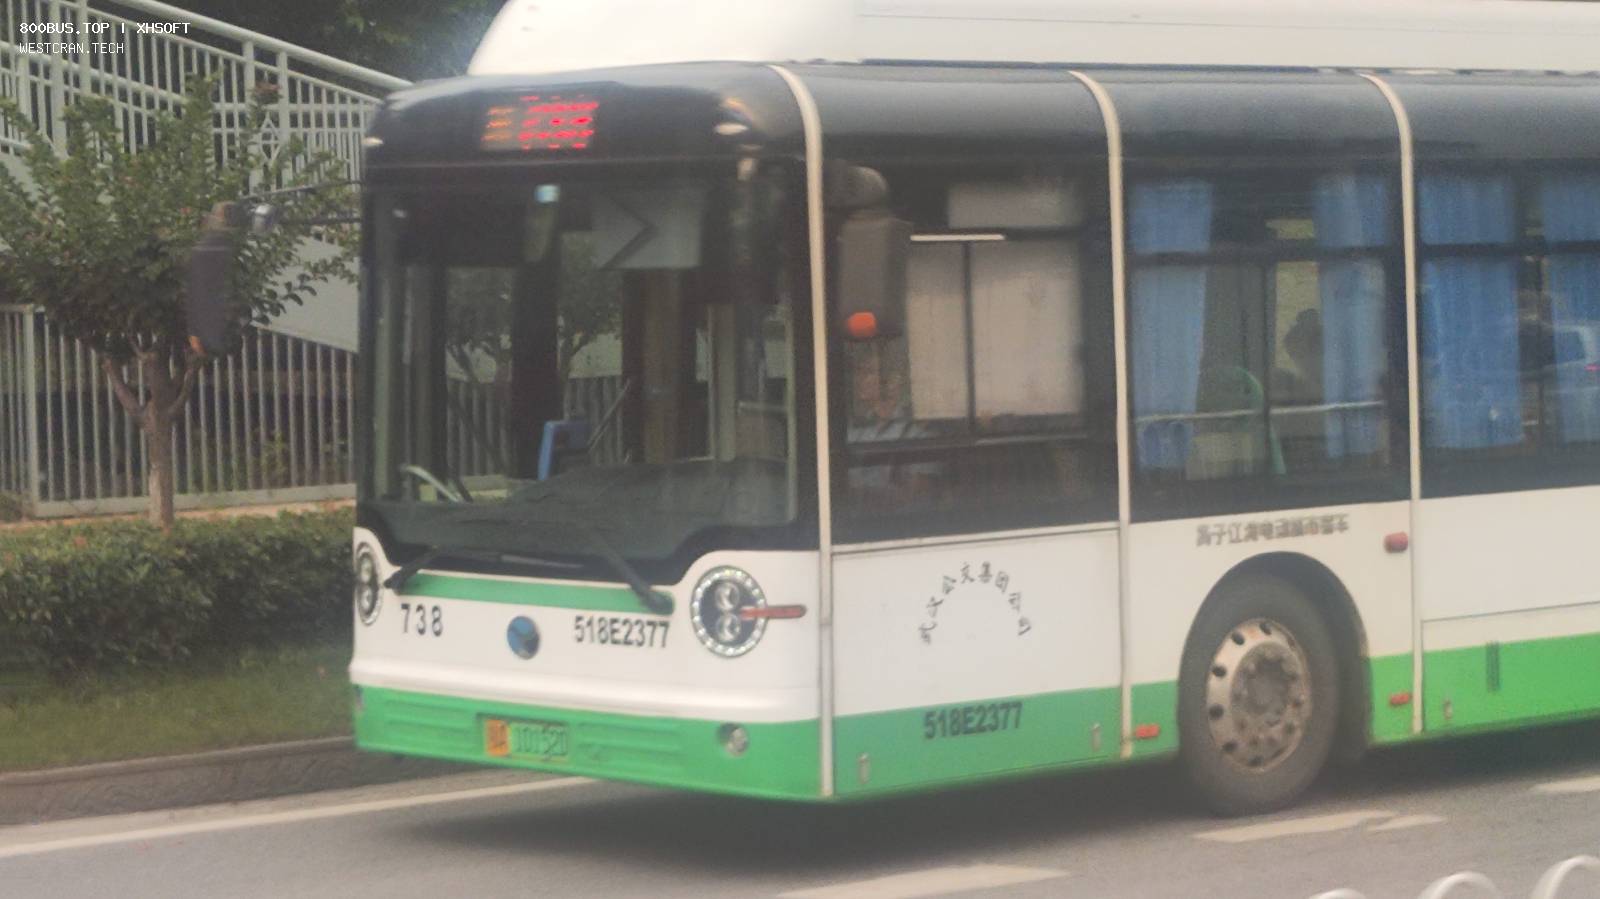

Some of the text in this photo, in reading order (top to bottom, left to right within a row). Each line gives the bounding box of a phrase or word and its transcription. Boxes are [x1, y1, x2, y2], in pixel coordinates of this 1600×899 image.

[401, 603, 444, 637] 738
[574, 615, 671, 649] 518E2377
[923, 701, 1024, 741] 518E2377
